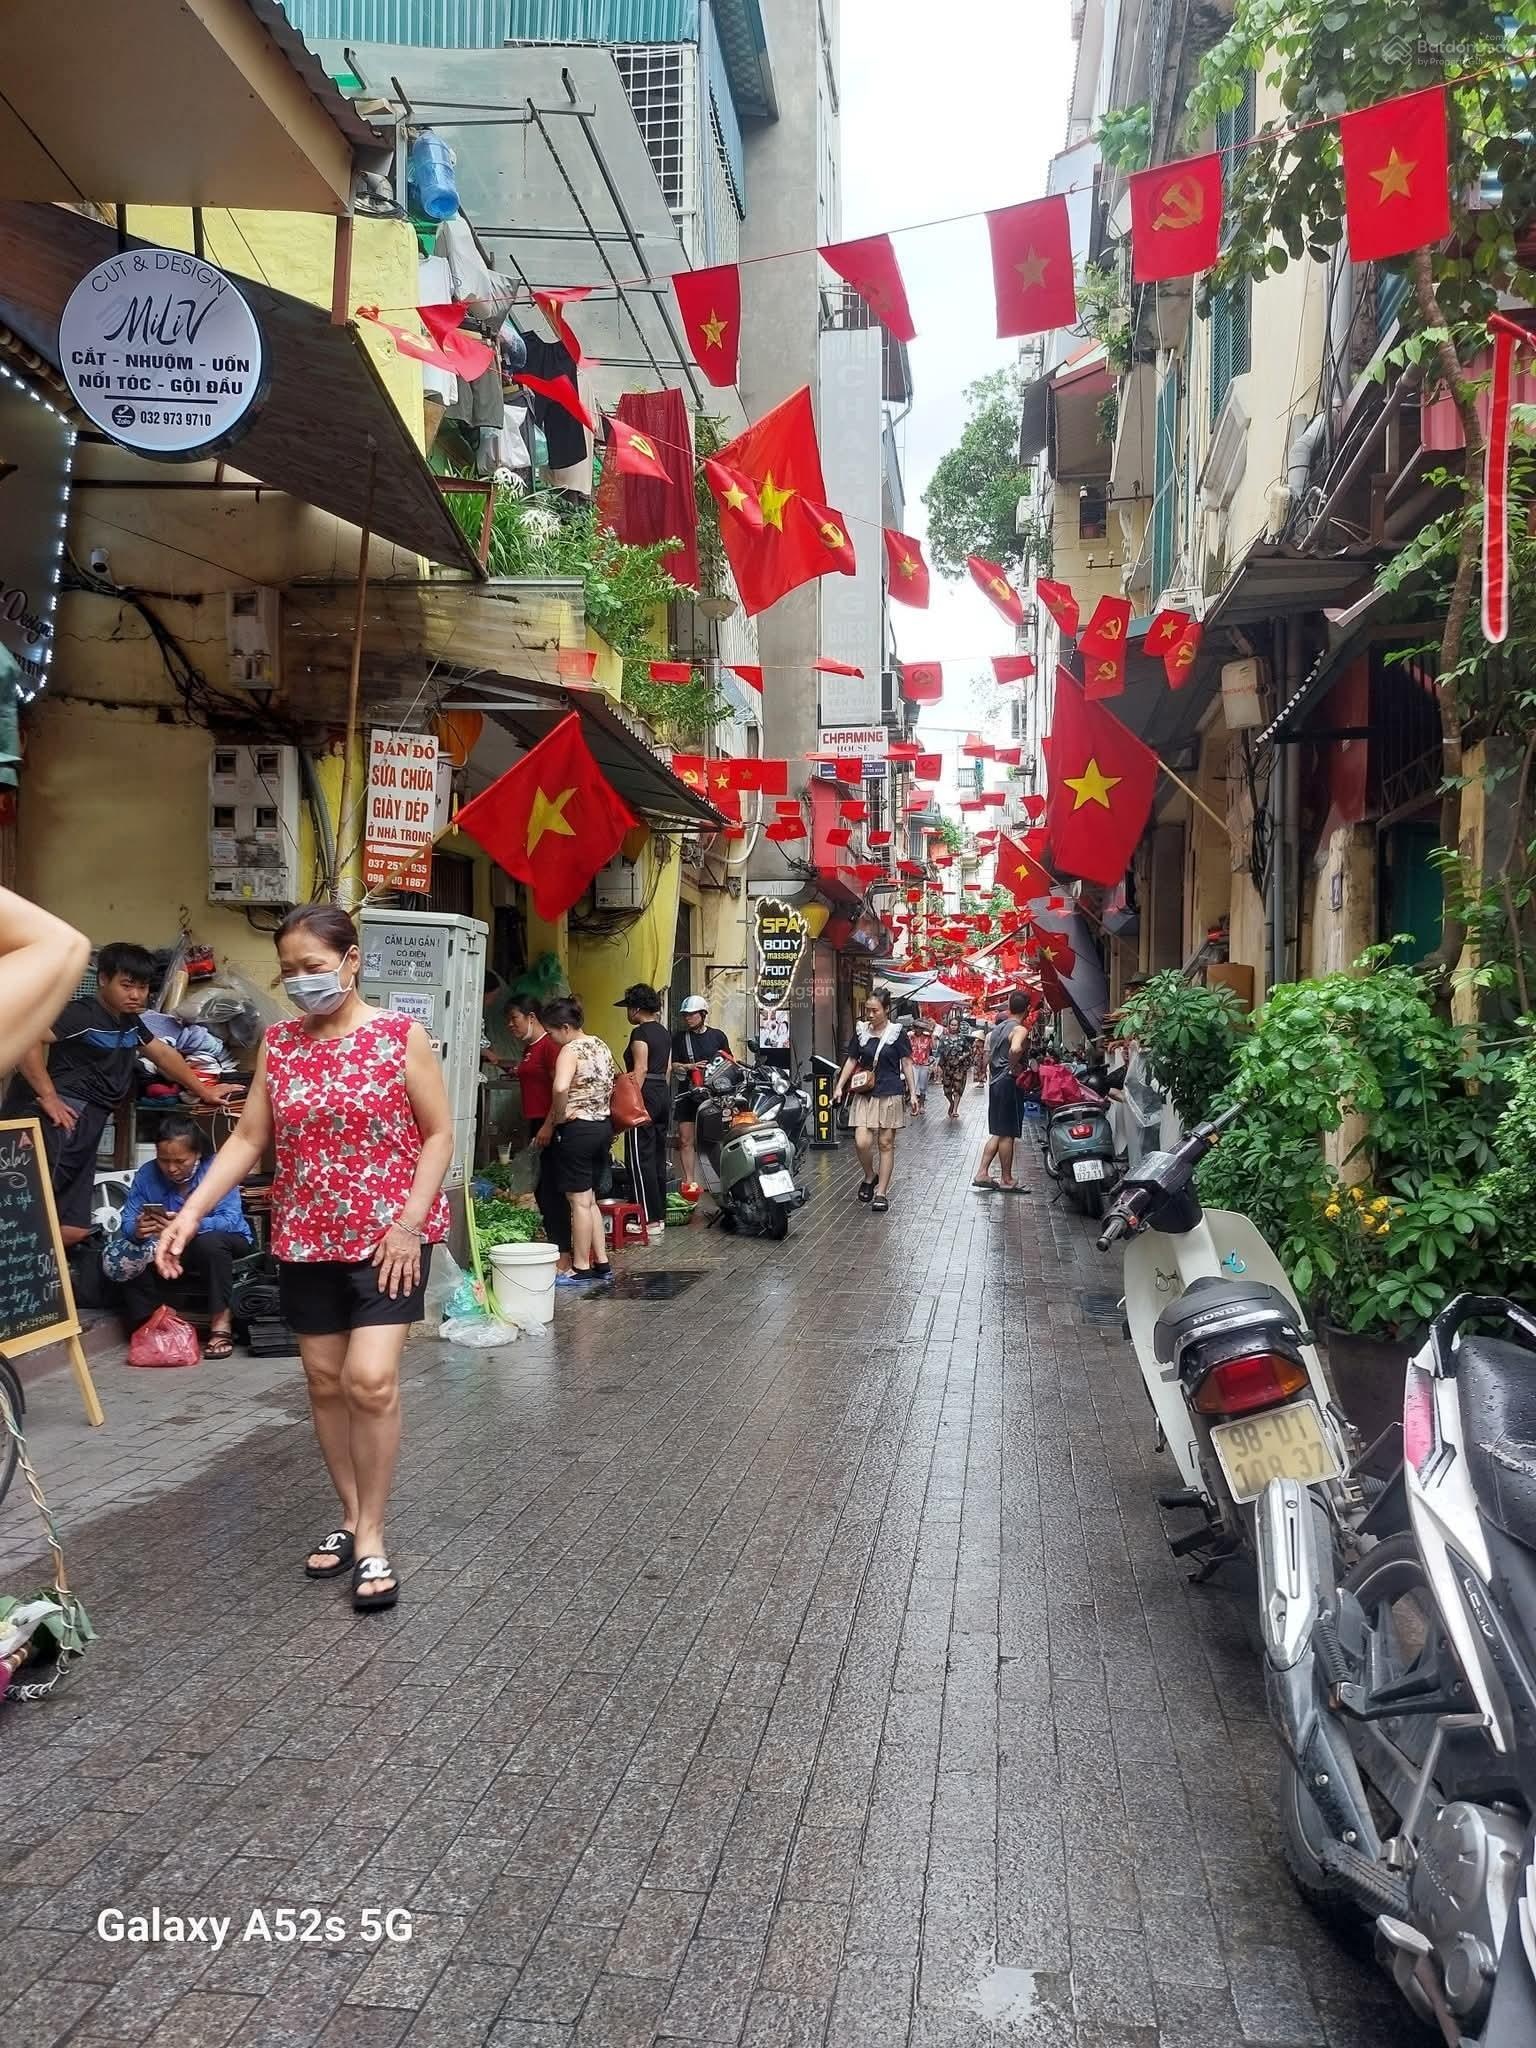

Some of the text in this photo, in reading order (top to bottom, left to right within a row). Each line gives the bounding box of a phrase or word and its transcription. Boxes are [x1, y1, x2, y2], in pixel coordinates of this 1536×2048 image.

[91, 253, 229, 297] CUT & DESIGN
[71, 346, 107, 366] CẮT
[125, 352, 193, 373] NHUỘM
[212, 354, 250, 373] UỐN
[78, 370, 111, 389] NỐI
[117, 373, 151, 391] TÓC
[170, 376, 200, 396] GỘI
[206, 375, 243, 395] ĐẦU
[140, 410, 160, 425] 032
[163, 411, 183, 426] 973
[186, 412, 211, 427] 9710
[374, 738, 436, 760] BÁN ĐỒ
[822, 731, 884, 745] CHARMING
[837, 744, 870, 753] HOUSE
[371, 760, 433, 792] SỬA CHỮA
[372, 794, 429, 823] GIÀY DÉP
[367, 821, 432, 844] Ở NHÀ TRONG
[762, 917, 800, 933] SPA
[763, 939, 800, 951] BODY
[767, 951, 798, 961] massage
[765, 965, 791, 976] FOOT
[761, 979, 789, 988] massage
[818, 1077, 829, 1140] FOOT
[1192, 1304, 1249, 1326] HONDA
